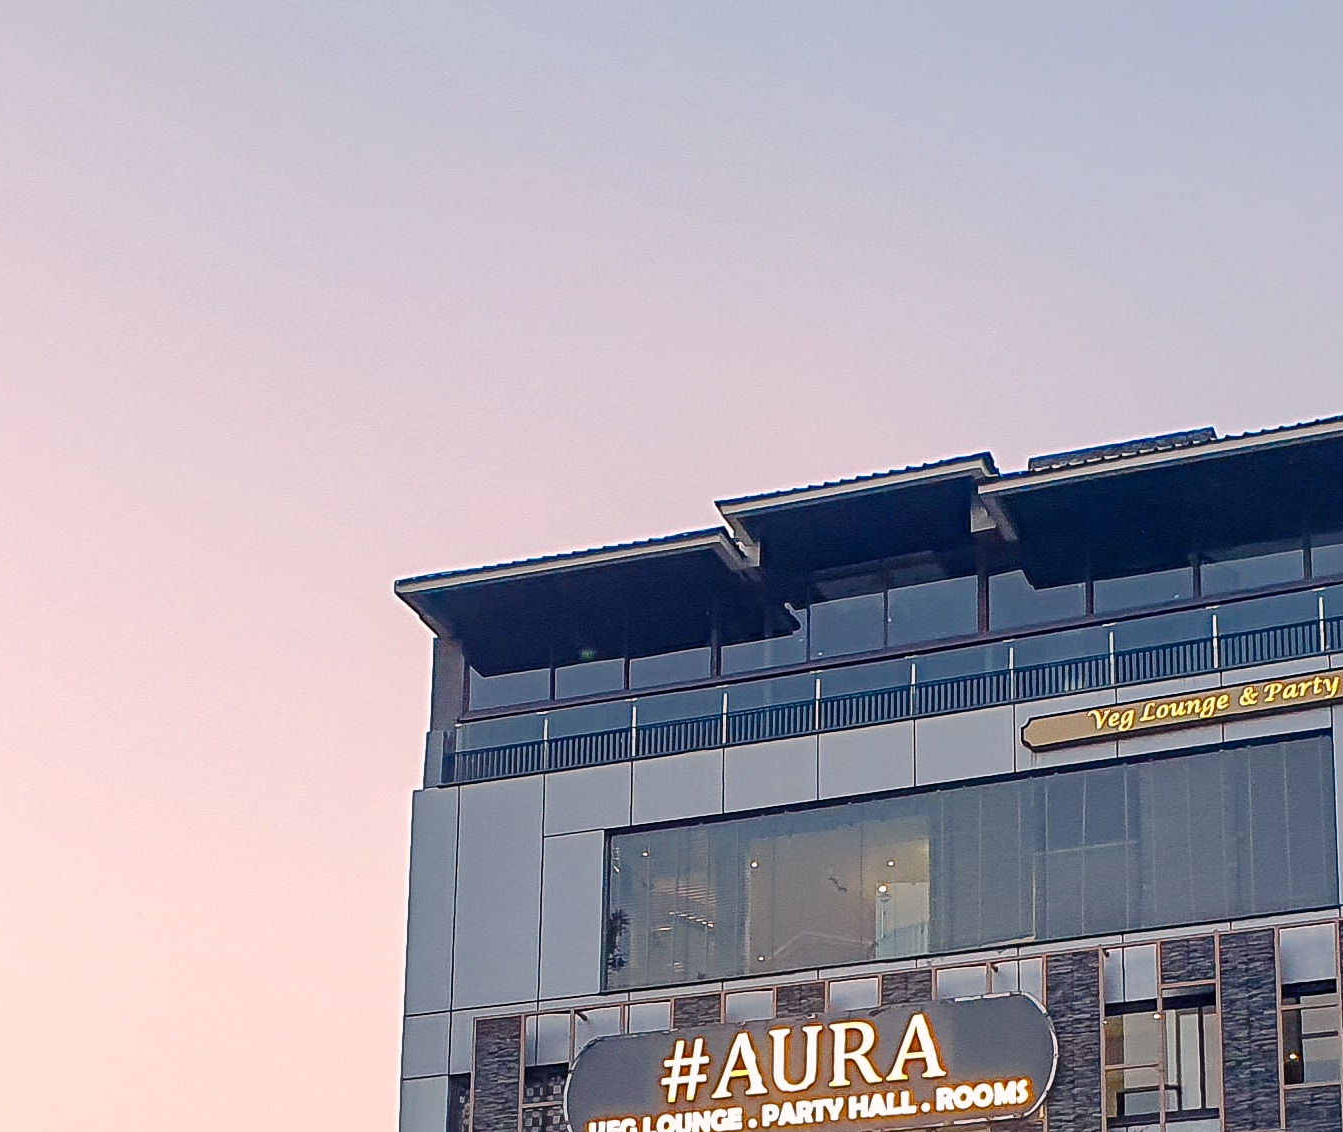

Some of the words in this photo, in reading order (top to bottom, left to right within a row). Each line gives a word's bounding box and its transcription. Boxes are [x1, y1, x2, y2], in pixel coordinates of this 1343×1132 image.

[1088, 706, 1134, 732] Veg
[1138, 694, 1229, 723] Lounge
[1238, 687, 1258, 706] &
[1262, 675, 1339, 701] Party
[659, 1012, 947, 1103] #AURA
[762, 1097, 842, 1127] PARTY
[848, 1091, 916, 1121] HALL
[935, 1079, 1030, 1111] ROOMS
